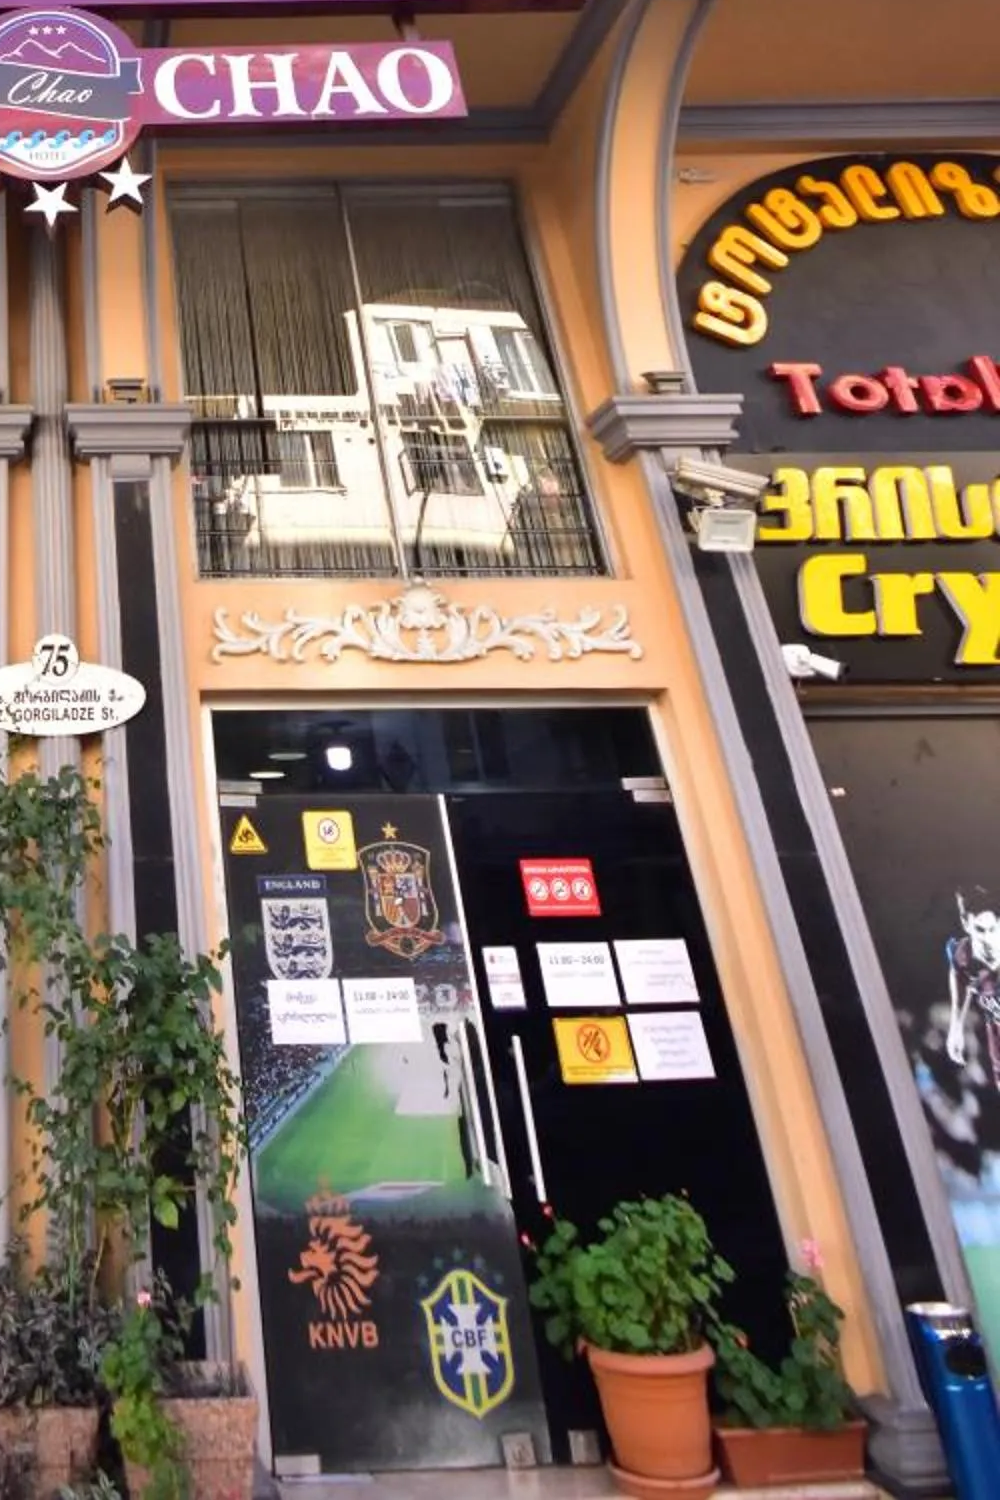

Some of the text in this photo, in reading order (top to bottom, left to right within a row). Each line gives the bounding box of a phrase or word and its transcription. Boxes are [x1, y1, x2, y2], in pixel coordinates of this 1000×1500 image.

[7, 71, 93, 105] Chao
[153, 47, 454, 120] CHAO
[692, 160, 1000, 346] ტოტალიზ
[759, 465, 1000, 541] კრის
[40, 644, 70, 677] 75
[14, 707, 95, 722] GORGILADZE
[264, 879, 321, 890] ENGLAND
[308, 1321, 379, 1348] KNVB
[451, 1328, 488, 1348] CBF
